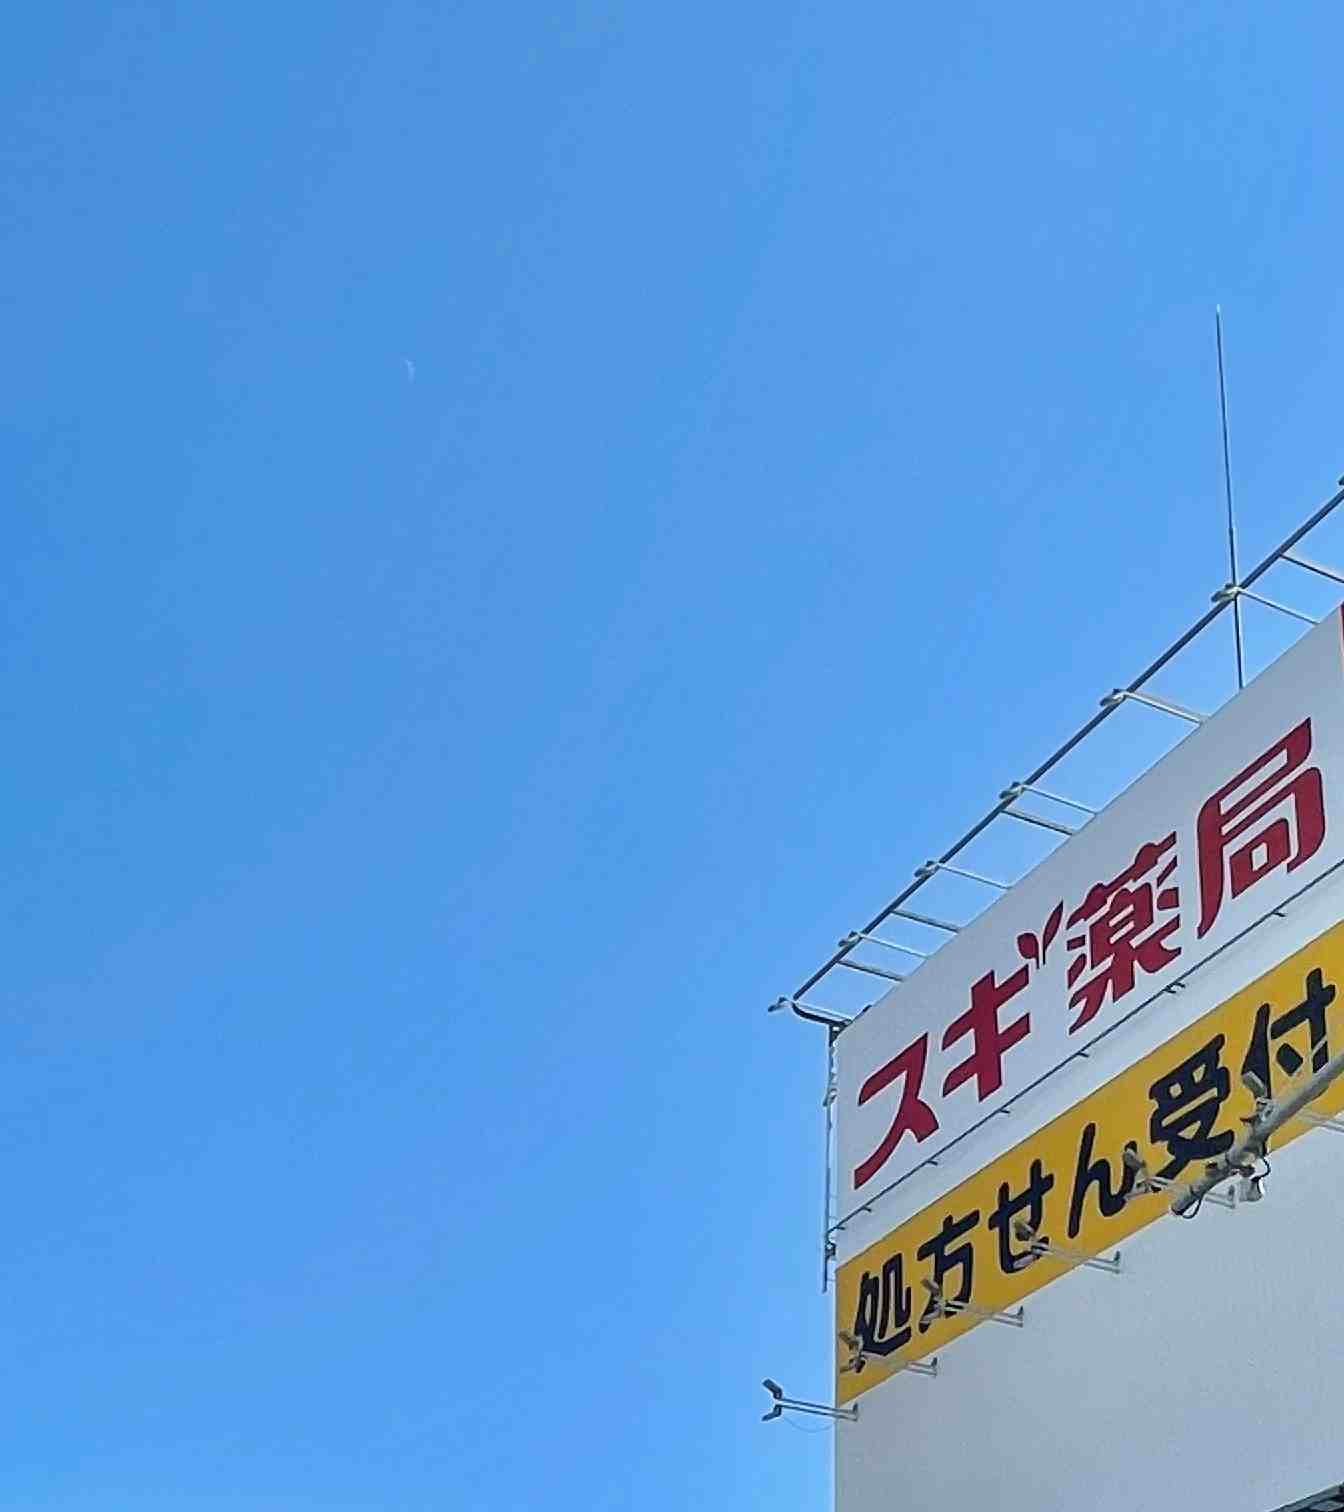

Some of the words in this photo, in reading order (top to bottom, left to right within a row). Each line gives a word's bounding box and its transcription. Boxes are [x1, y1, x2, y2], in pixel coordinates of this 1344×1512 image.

[853, 717, 1326, 1190] スギ薬局
[854, 967, 1336, 1373] 処方せん受付
